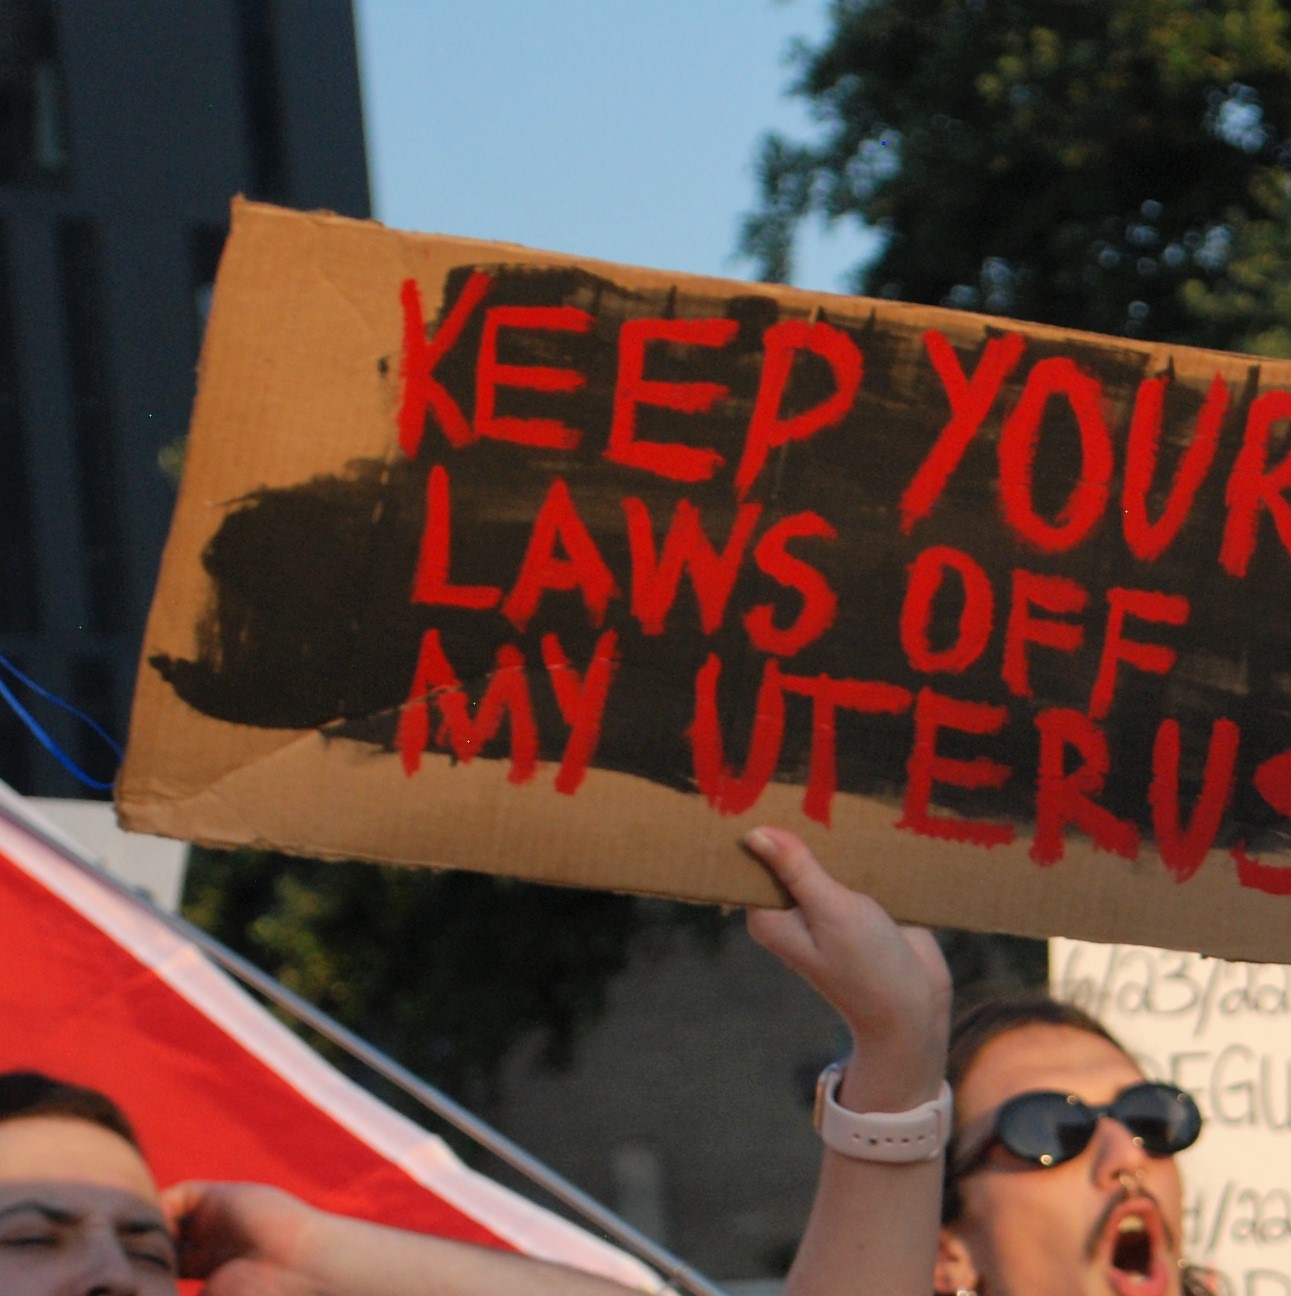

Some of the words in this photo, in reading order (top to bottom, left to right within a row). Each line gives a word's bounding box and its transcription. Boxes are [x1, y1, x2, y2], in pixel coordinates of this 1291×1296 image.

[396, 270, 865, 500] KEEP
[411, 464, 837, 657] LAWS
[899, 545, 1190, 716] OFF
[396, 628, 618, 797] MY
